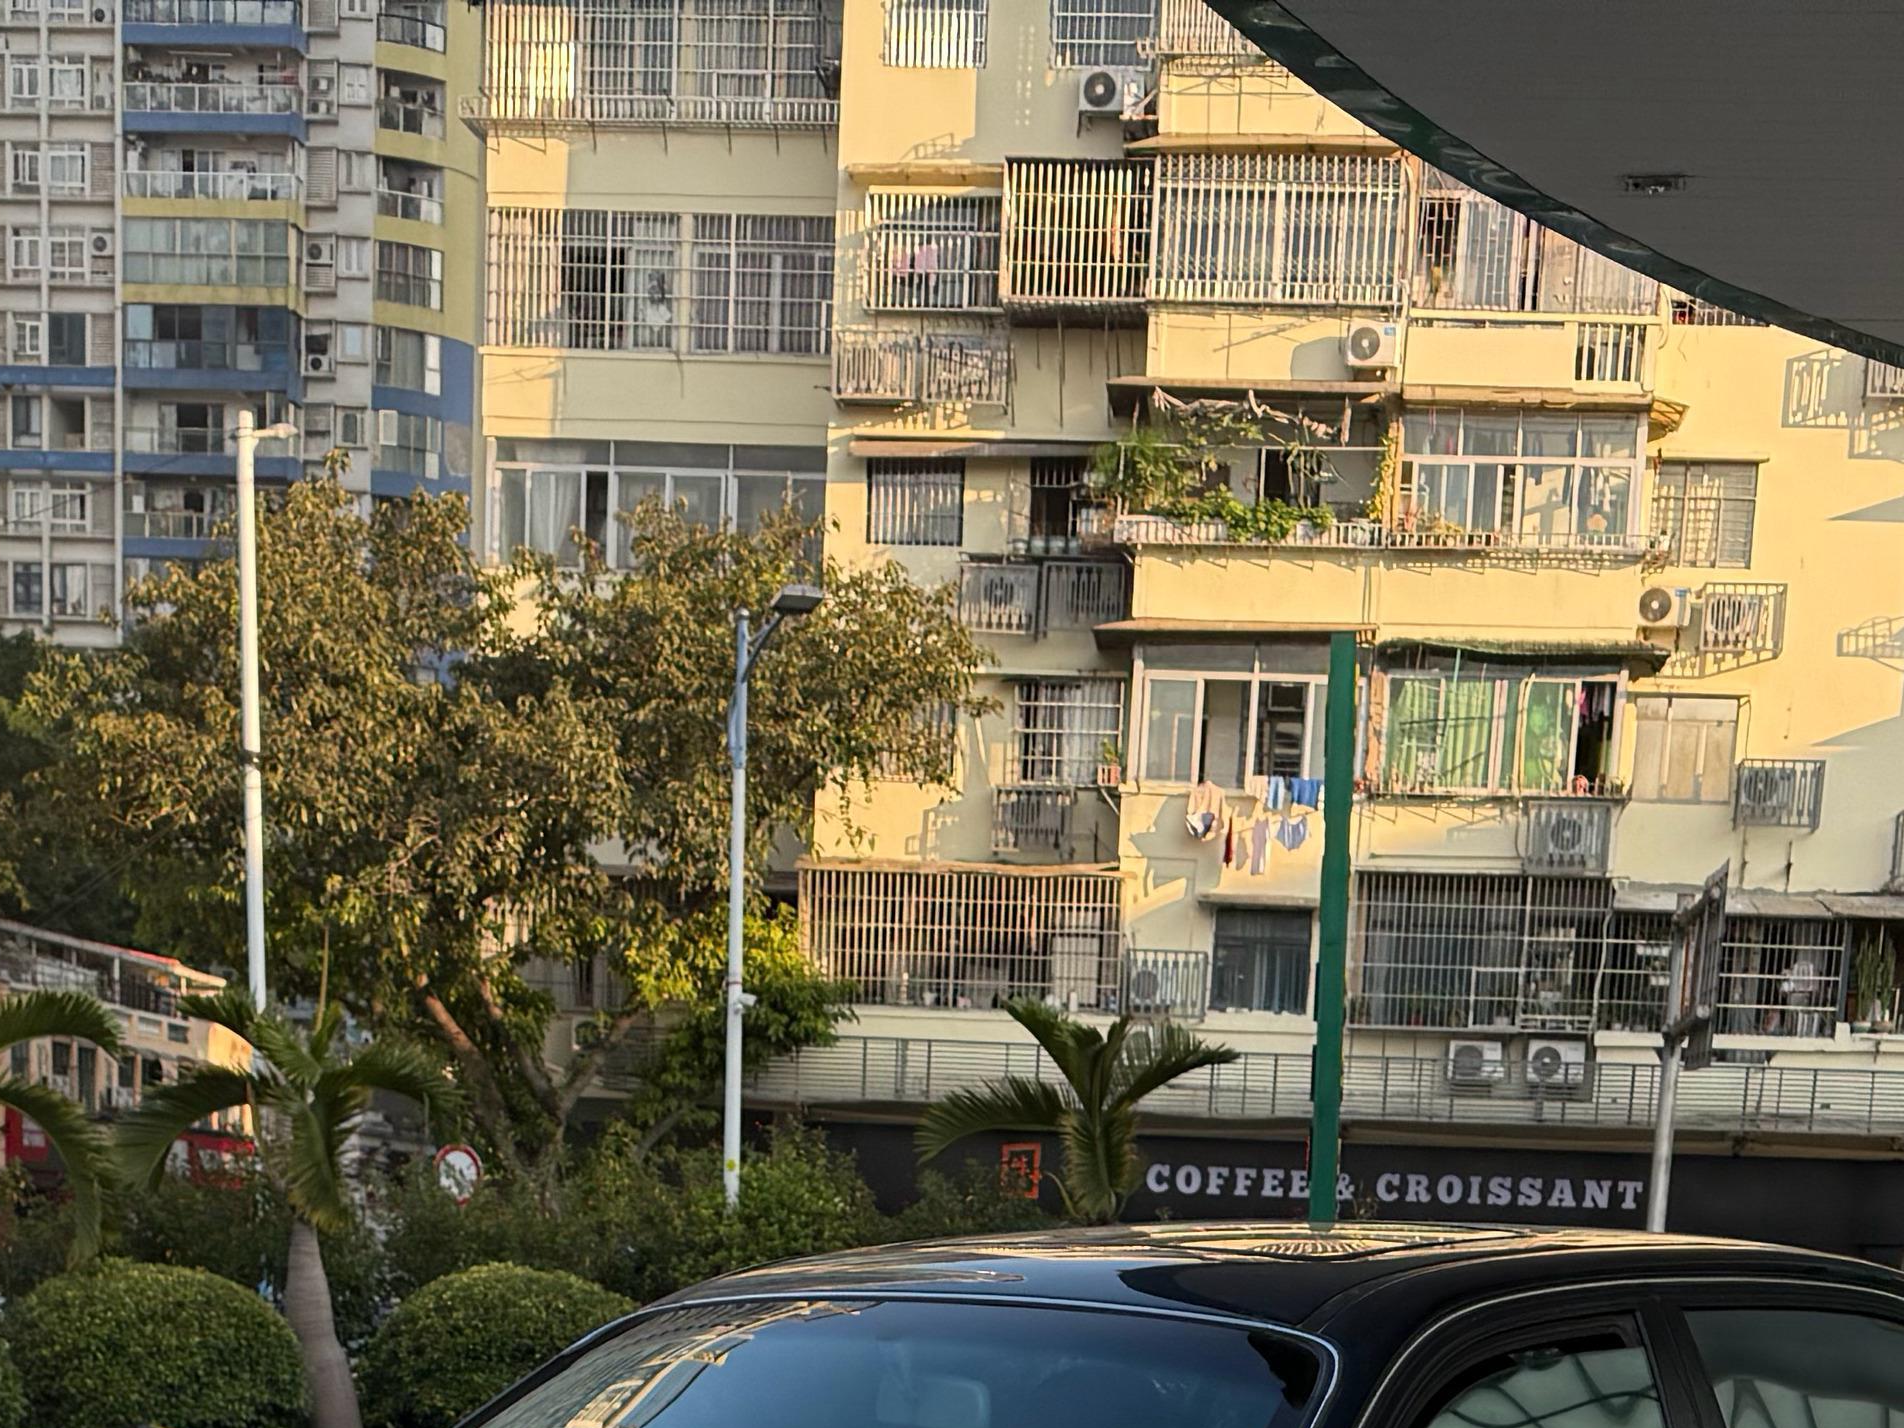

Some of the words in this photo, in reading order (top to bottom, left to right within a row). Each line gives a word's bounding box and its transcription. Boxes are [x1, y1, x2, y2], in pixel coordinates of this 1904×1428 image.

[1145, 1162, 1311, 1200] COFFEE
[1336, 1171, 1355, 1200] &
[1376, 1172, 1644, 1210] CROISSANT
